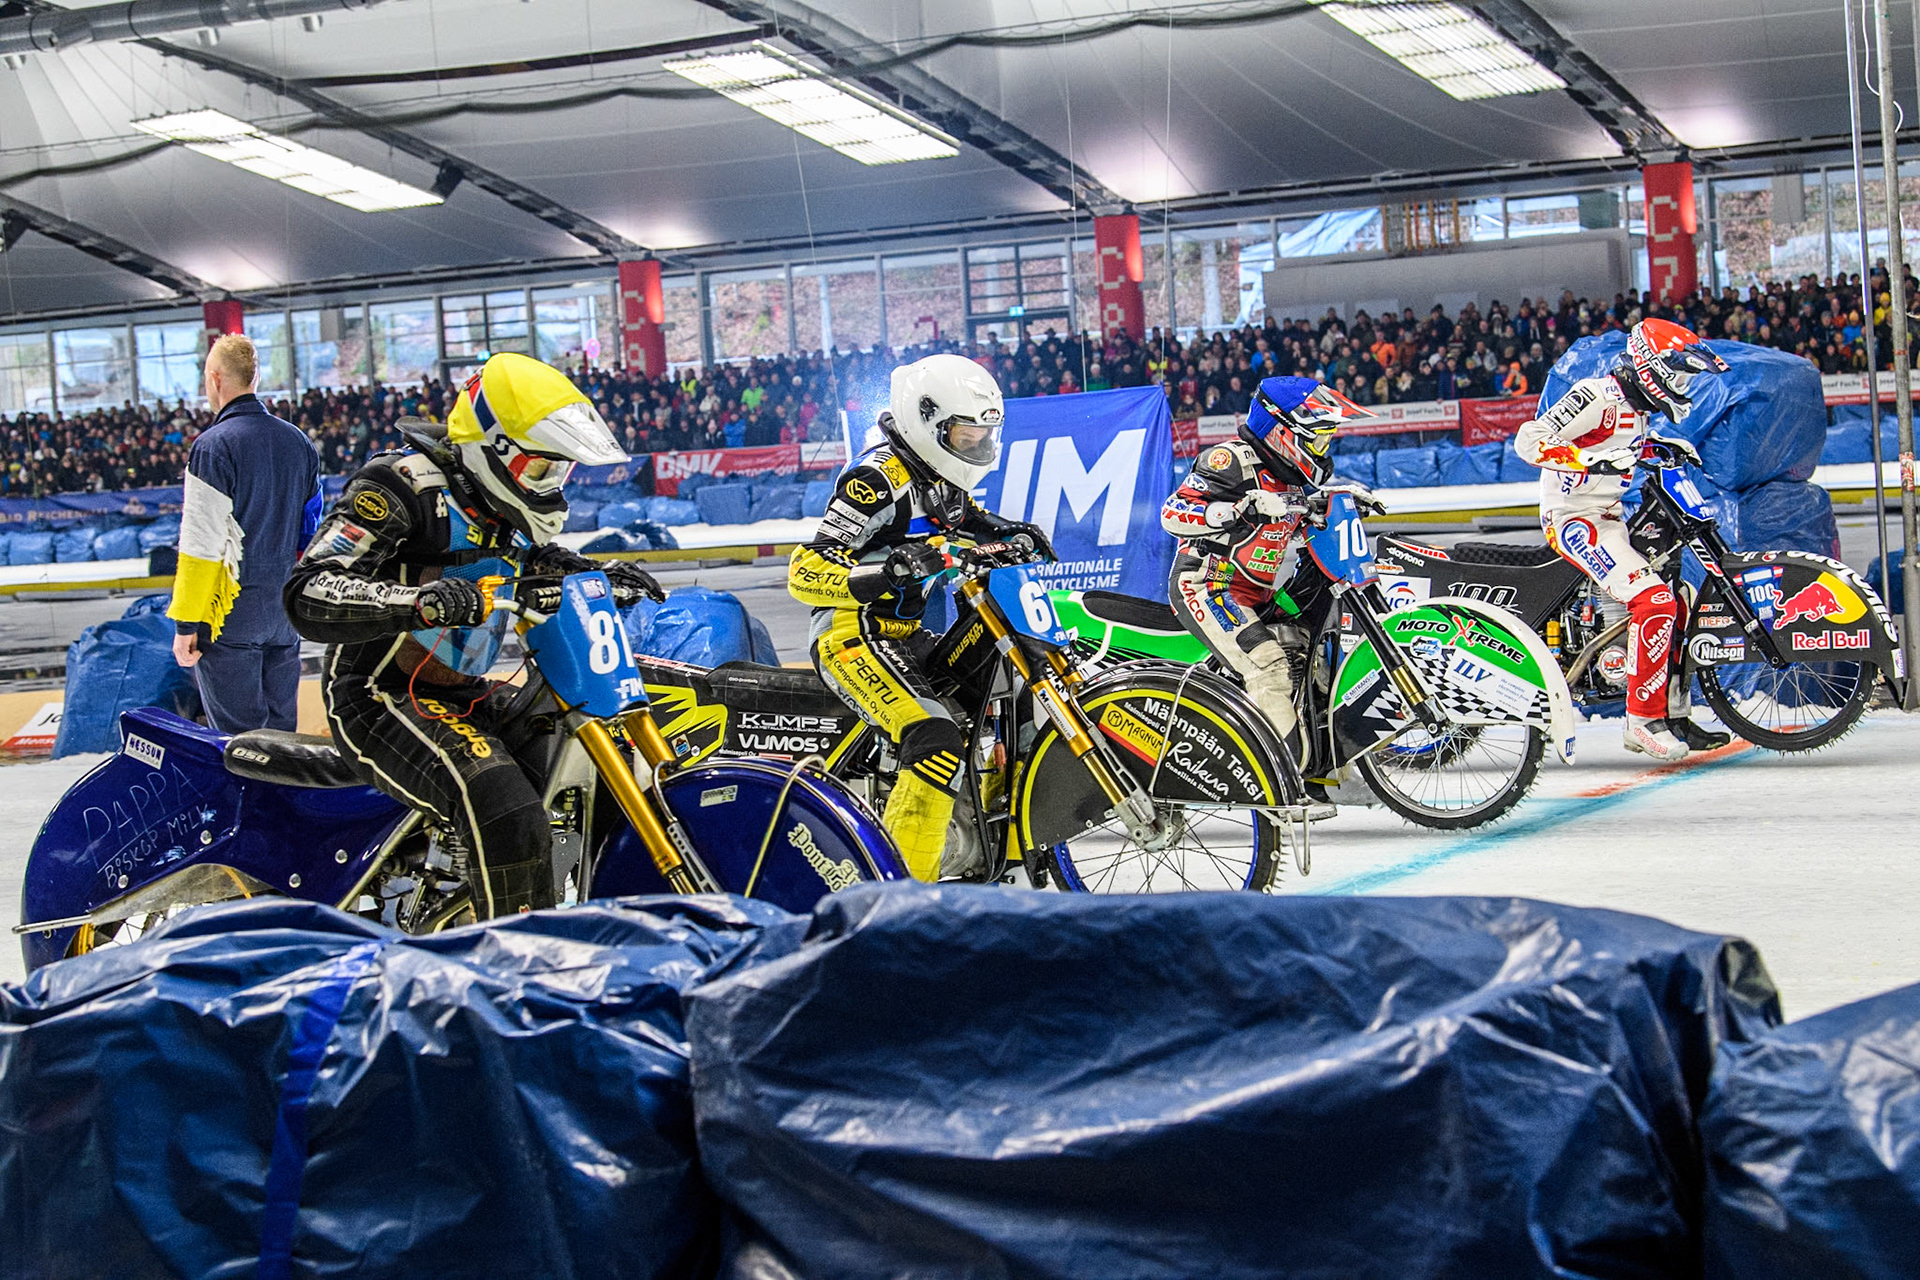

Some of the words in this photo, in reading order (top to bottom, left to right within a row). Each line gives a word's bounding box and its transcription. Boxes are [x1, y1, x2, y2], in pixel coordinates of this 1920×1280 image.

[967, 428, 1147, 549] IM
[1386, 547, 1425, 567] daytona
[1568, 533, 1609, 581] Nilsson
[794, 566, 846, 586] PERTU
[837, 588, 849, 599] Ltd
[1448, 582, 1518, 607] 100
[1397, 620, 1449, 633] MOTO
[588, 610, 636, 675] 81
[1793, 632, 1829, 649] Red
[1834, 630, 1869, 648] Bull
[1700, 643, 1745, 659] Nilsson
[850, 656, 899, 705] PERTU
[1453, 658, 1493, 682] ILV
[833, 660, 870, 703] Components
[870, 701, 881, 714] Oy
[879, 708, 891, 725] Ltd
[741, 713, 838, 730] KJMPS
[738, 733, 819, 753] VUMOS
[1144, 698, 1227, 760] Mäenpään
[1225, 754, 1266, 802] Taksi
